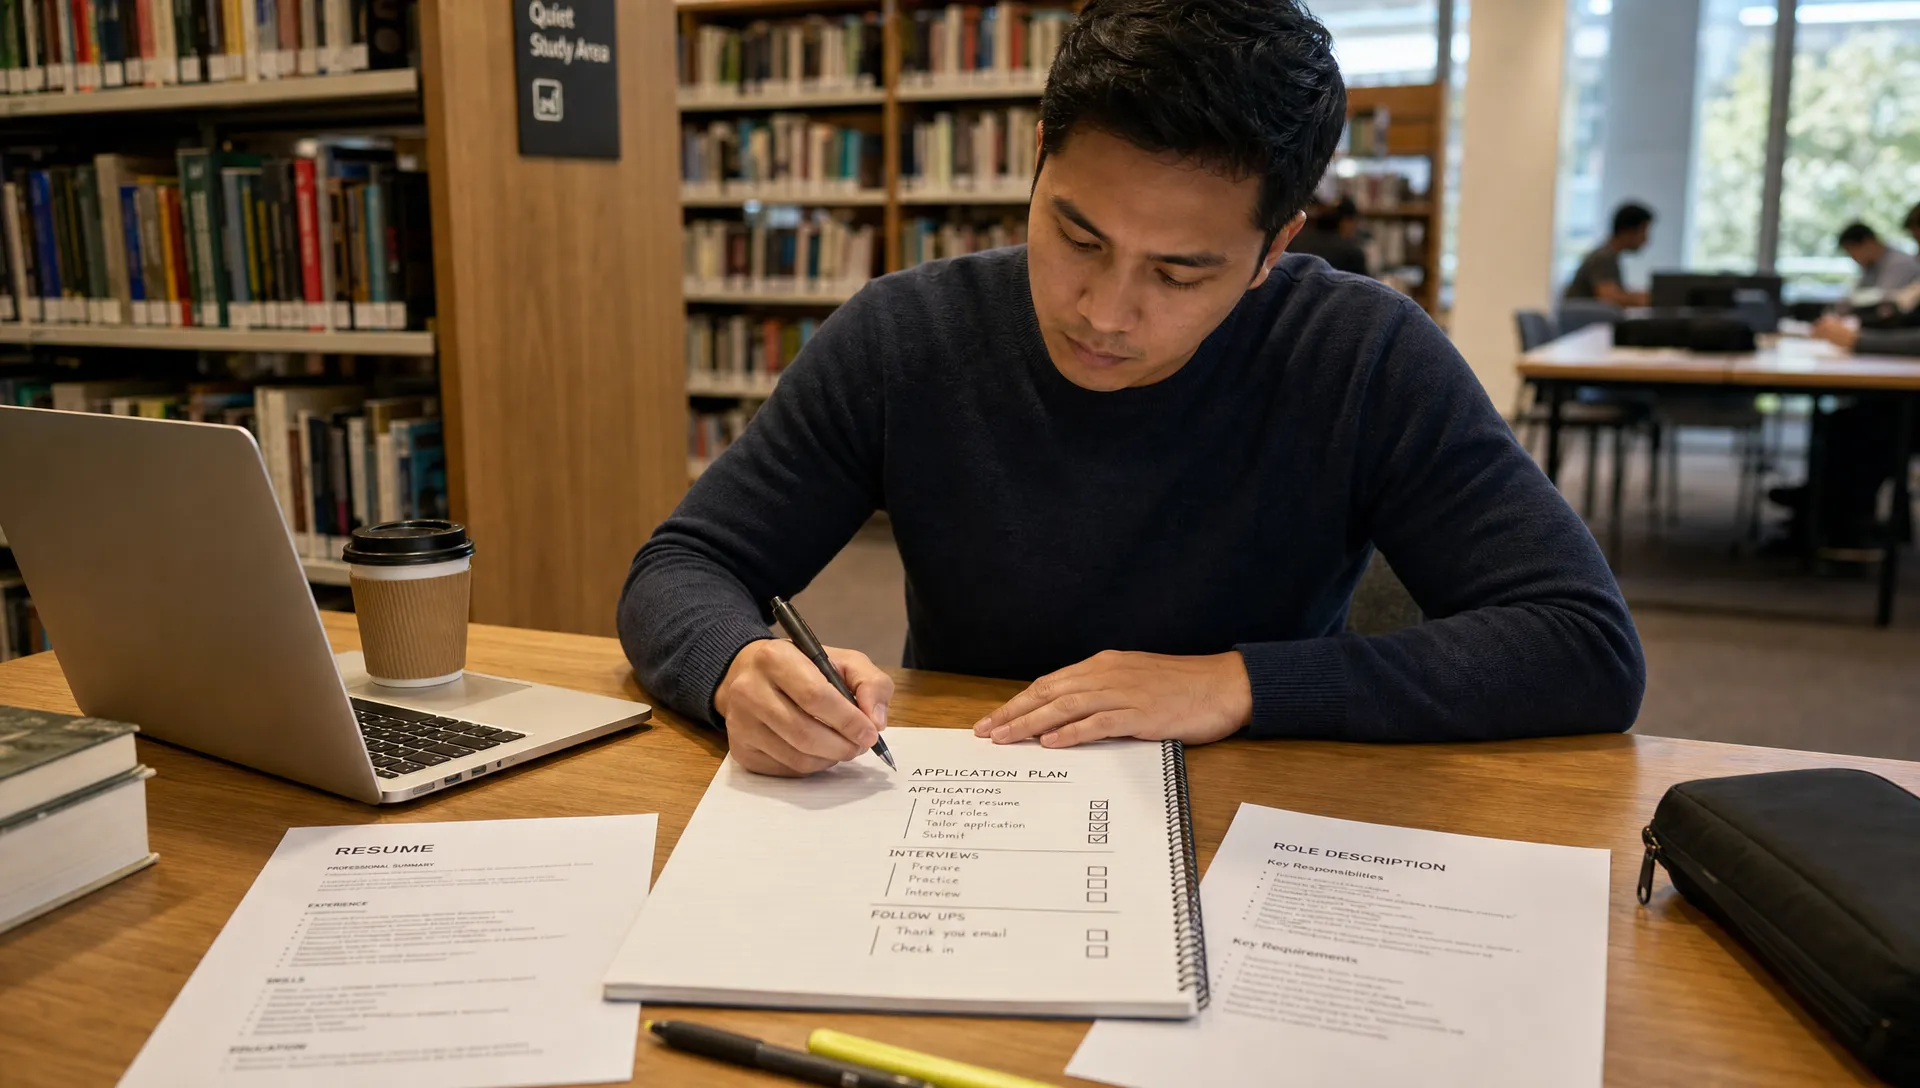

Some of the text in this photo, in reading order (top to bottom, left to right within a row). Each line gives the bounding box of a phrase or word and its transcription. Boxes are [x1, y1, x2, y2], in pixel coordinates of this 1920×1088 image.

[529, 0, 575, 29] Quiet
[530, 32, 610, 65] Study Area
[911, 768, 1068, 778] APPLICATION PLAN
[908, 786, 1002, 795] APPLICATIONS
[931, 798, 972, 807] Update
[928, 808, 988, 817] Find roles
[926, 819, 1026, 831] Tailor application
[922, 831, 965, 840] Submit
[335, 843, 435, 856] RESUME
[888, 849, 979, 860] INTERVIEWS
[1273, 841, 1446, 872] ROLE DESCRIPTION
[911, 862, 961, 874] Prepare
[1267, 858, 1290, 869] Key
[908, 874, 960, 885] Practice
[904, 887, 961, 898] Interview
[870, 910, 966, 921] FOLLOW UPS
[896, 926, 1007, 940] Thank you email
[890, 942, 954, 955] Check in
[1232, 938, 1259, 950] Key
